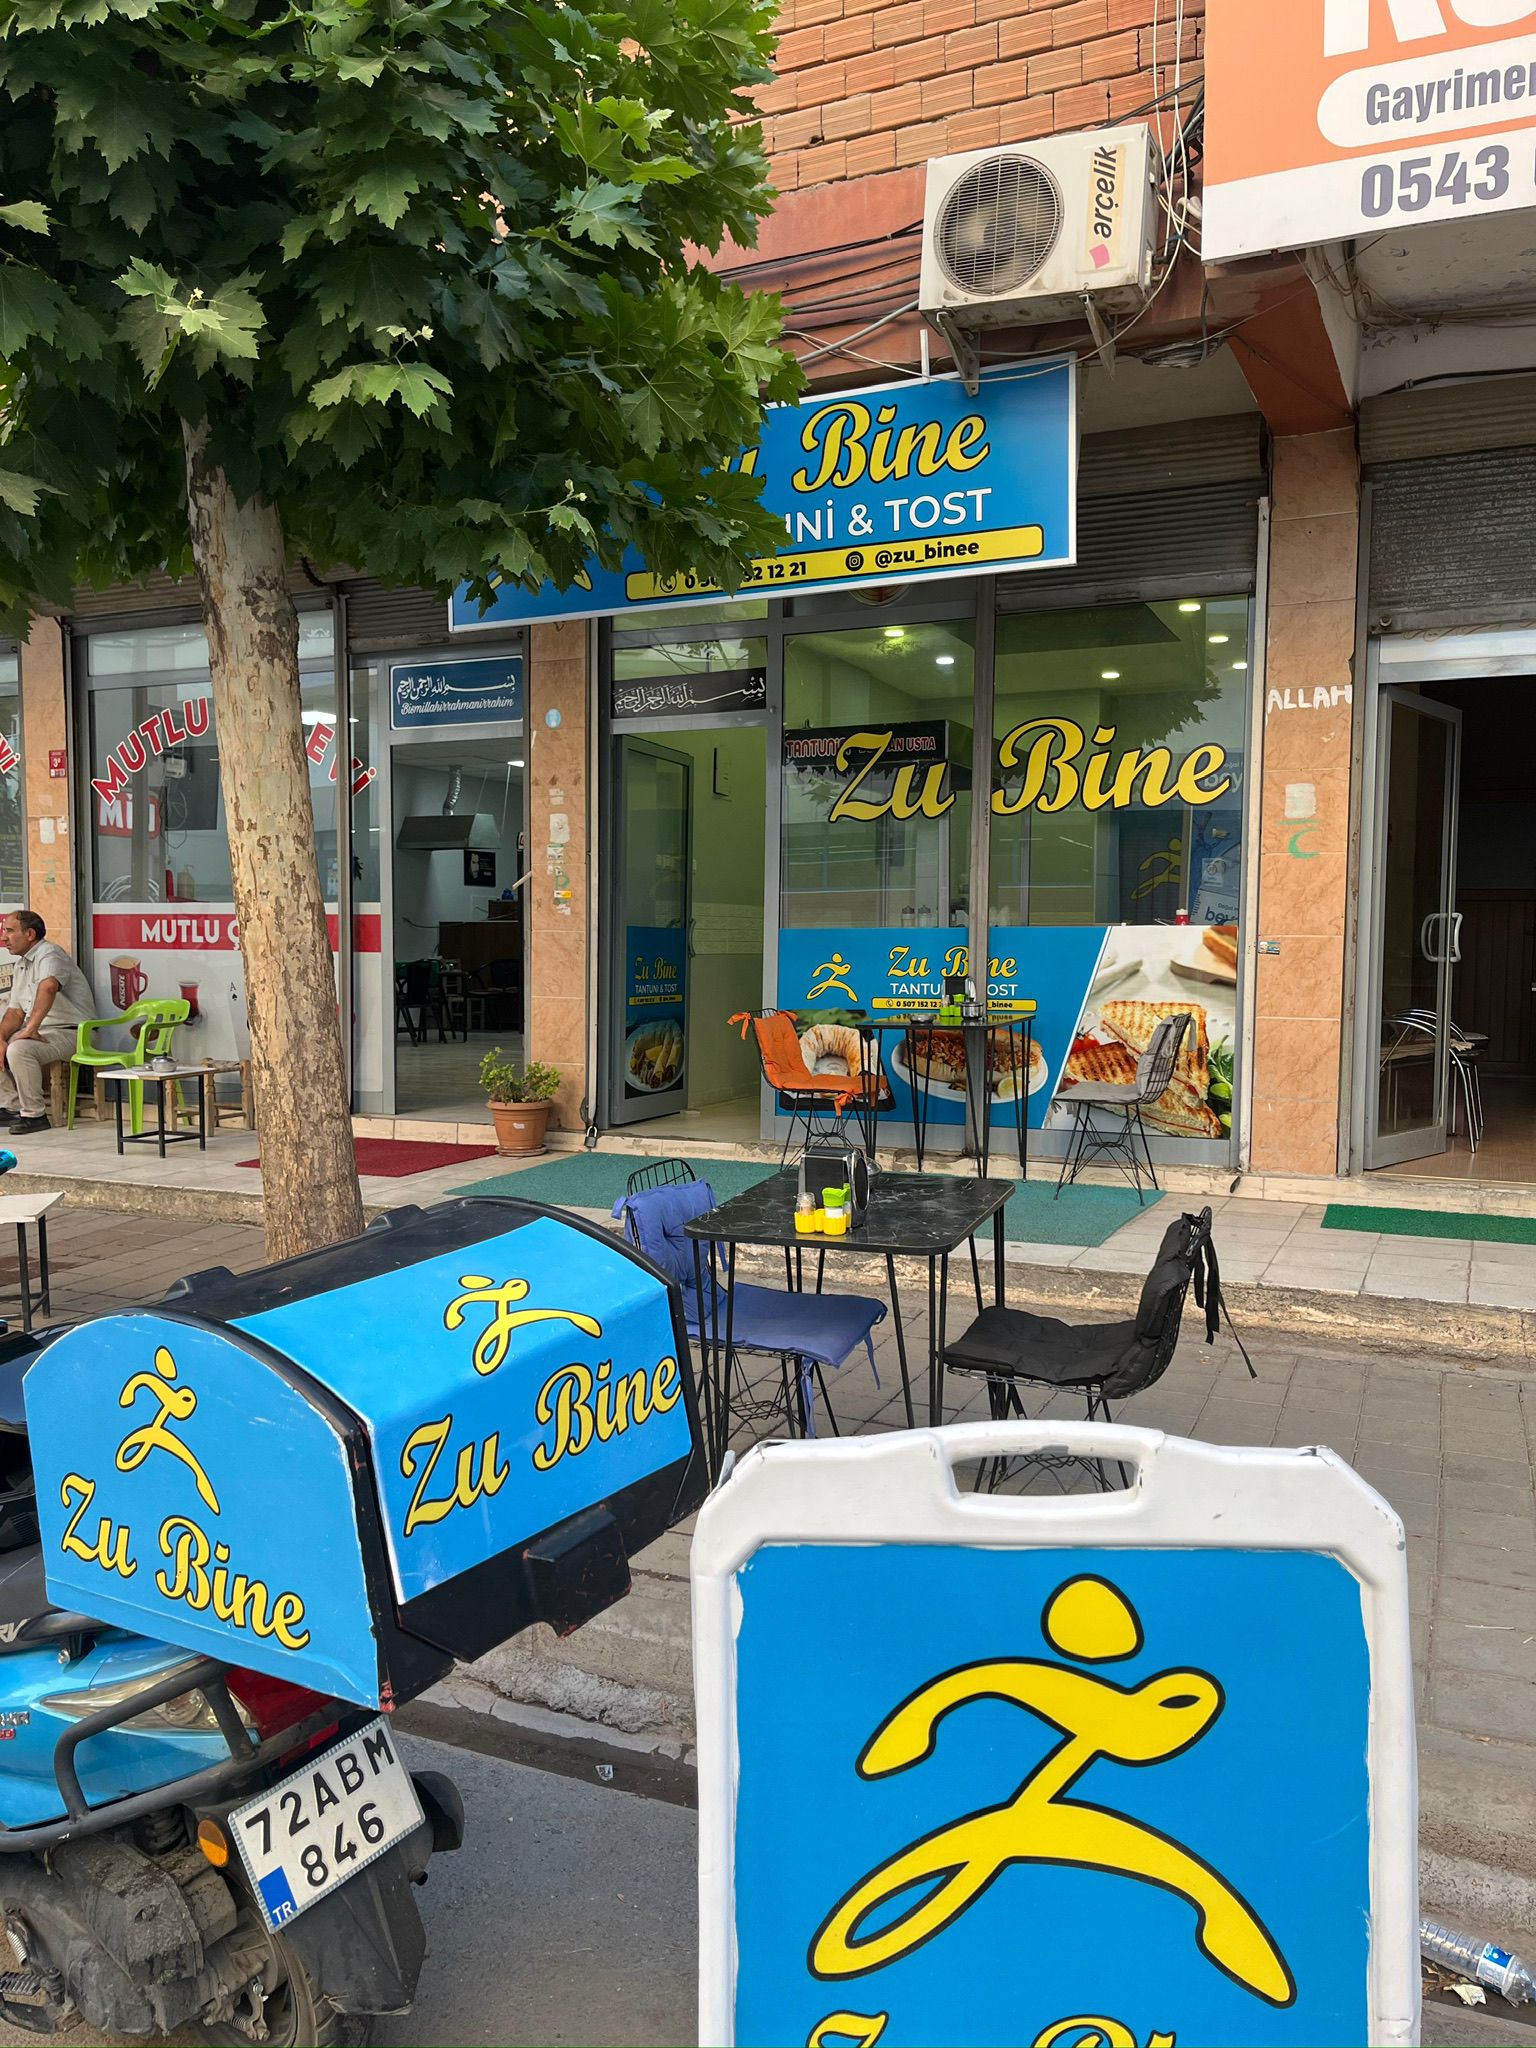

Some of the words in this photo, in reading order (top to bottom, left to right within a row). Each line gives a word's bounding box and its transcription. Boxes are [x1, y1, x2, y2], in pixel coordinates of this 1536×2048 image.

[1093, 146, 1119, 239] arçelik
[1361, 145, 1510, 218] 0543
[791, 401, 991, 492] Bine
[848, 503, 874, 536] &
[884, 487, 992, 532] TOST
[767, 564, 785, 579] 12
[789, 561, 807, 577] 21
[875, 541, 980, 569] @zu_binee
[1266, 685, 1352, 715] ALLAH
[91, 696, 210, 806] MUTLU
[828, 730, 957, 824] Zu
[988, 716, 1231, 816] Bine
[905, 736, 937, 751] USTA
[141, 919, 220, 944] MUTLU
[887, 945, 931, 978] Zu
[401, 1412, 511, 1538] Zu
[531, 1354, 683, 1471] Bine
[60, 1471, 138, 1579] Zu
[155, 1513, 311, 1652] Bine
[300, 1802, 384, 1887] 846
[272, 1901, 294, 1924] TR
